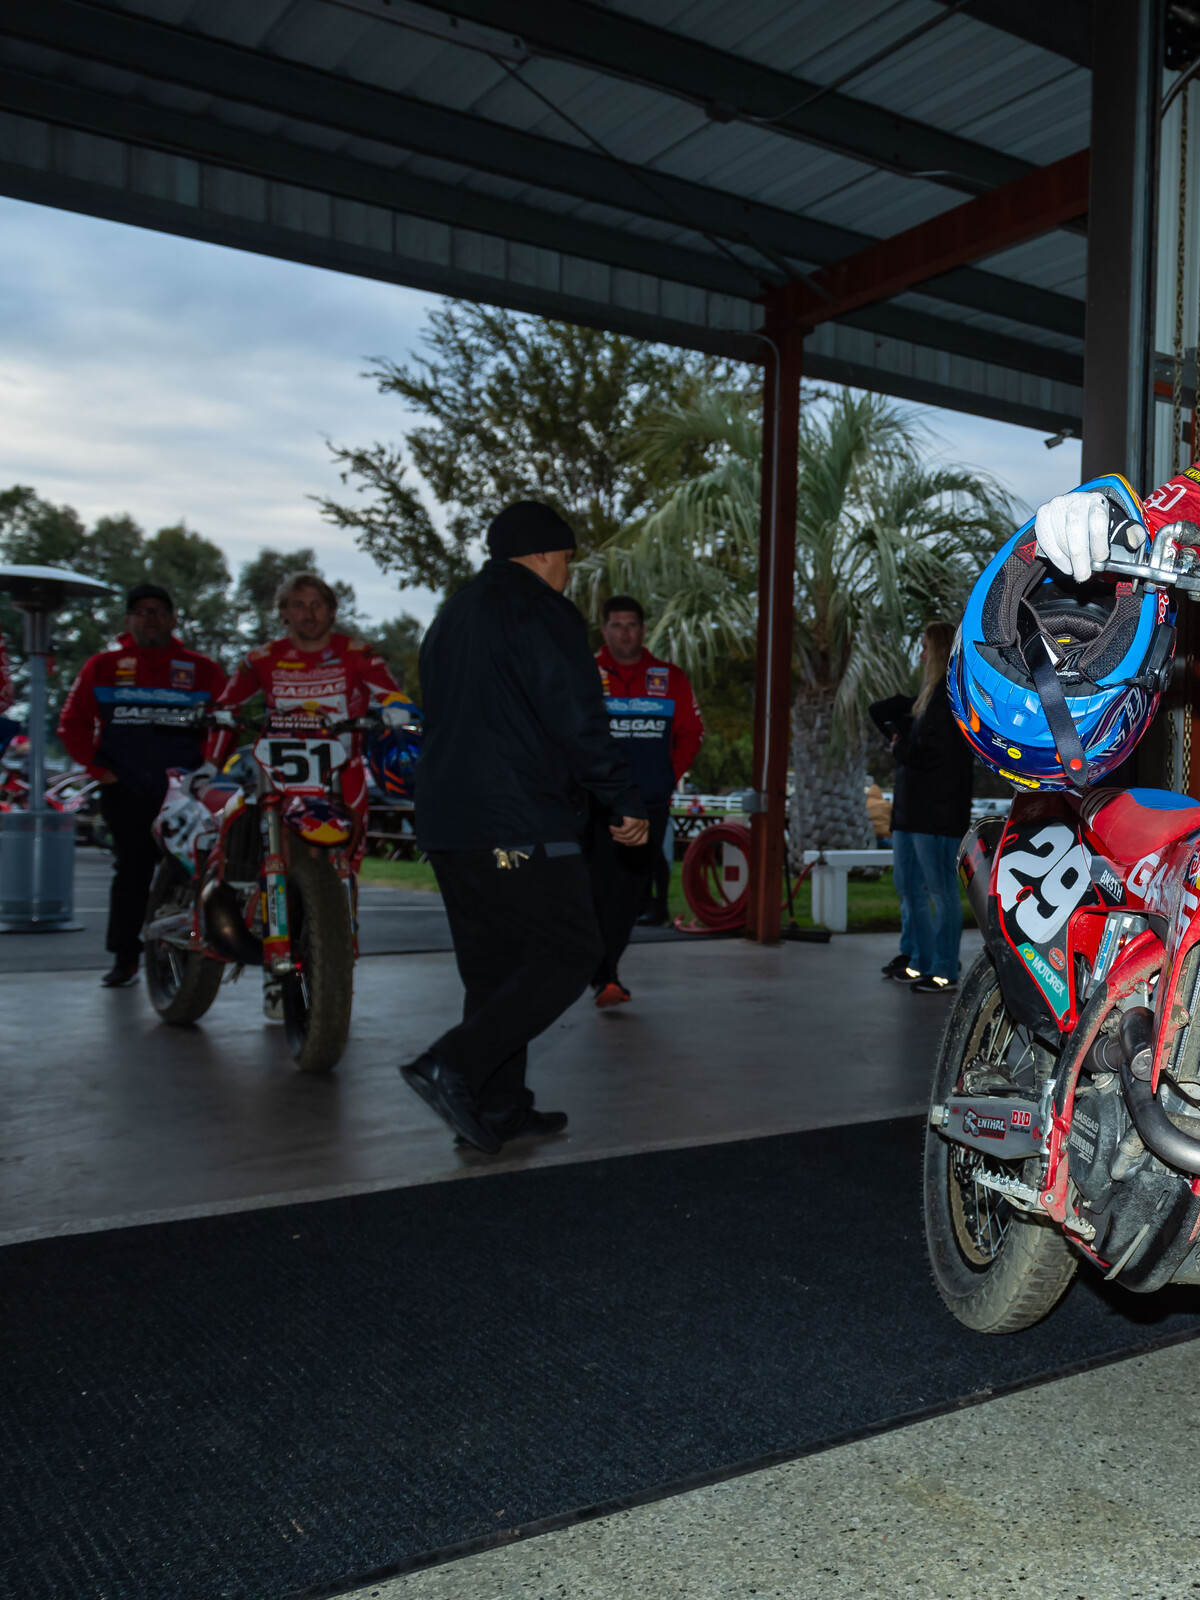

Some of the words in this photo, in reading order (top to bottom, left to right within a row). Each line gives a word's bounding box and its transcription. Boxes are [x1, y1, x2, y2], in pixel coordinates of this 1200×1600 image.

[609, 718, 667, 731] ASGAS
[270, 742, 332, 786] 51
[996, 825, 1093, 943] 29
[1100, 869, 1124, 900] BN3TH
[1031, 956, 1066, 998] MOTOREX
